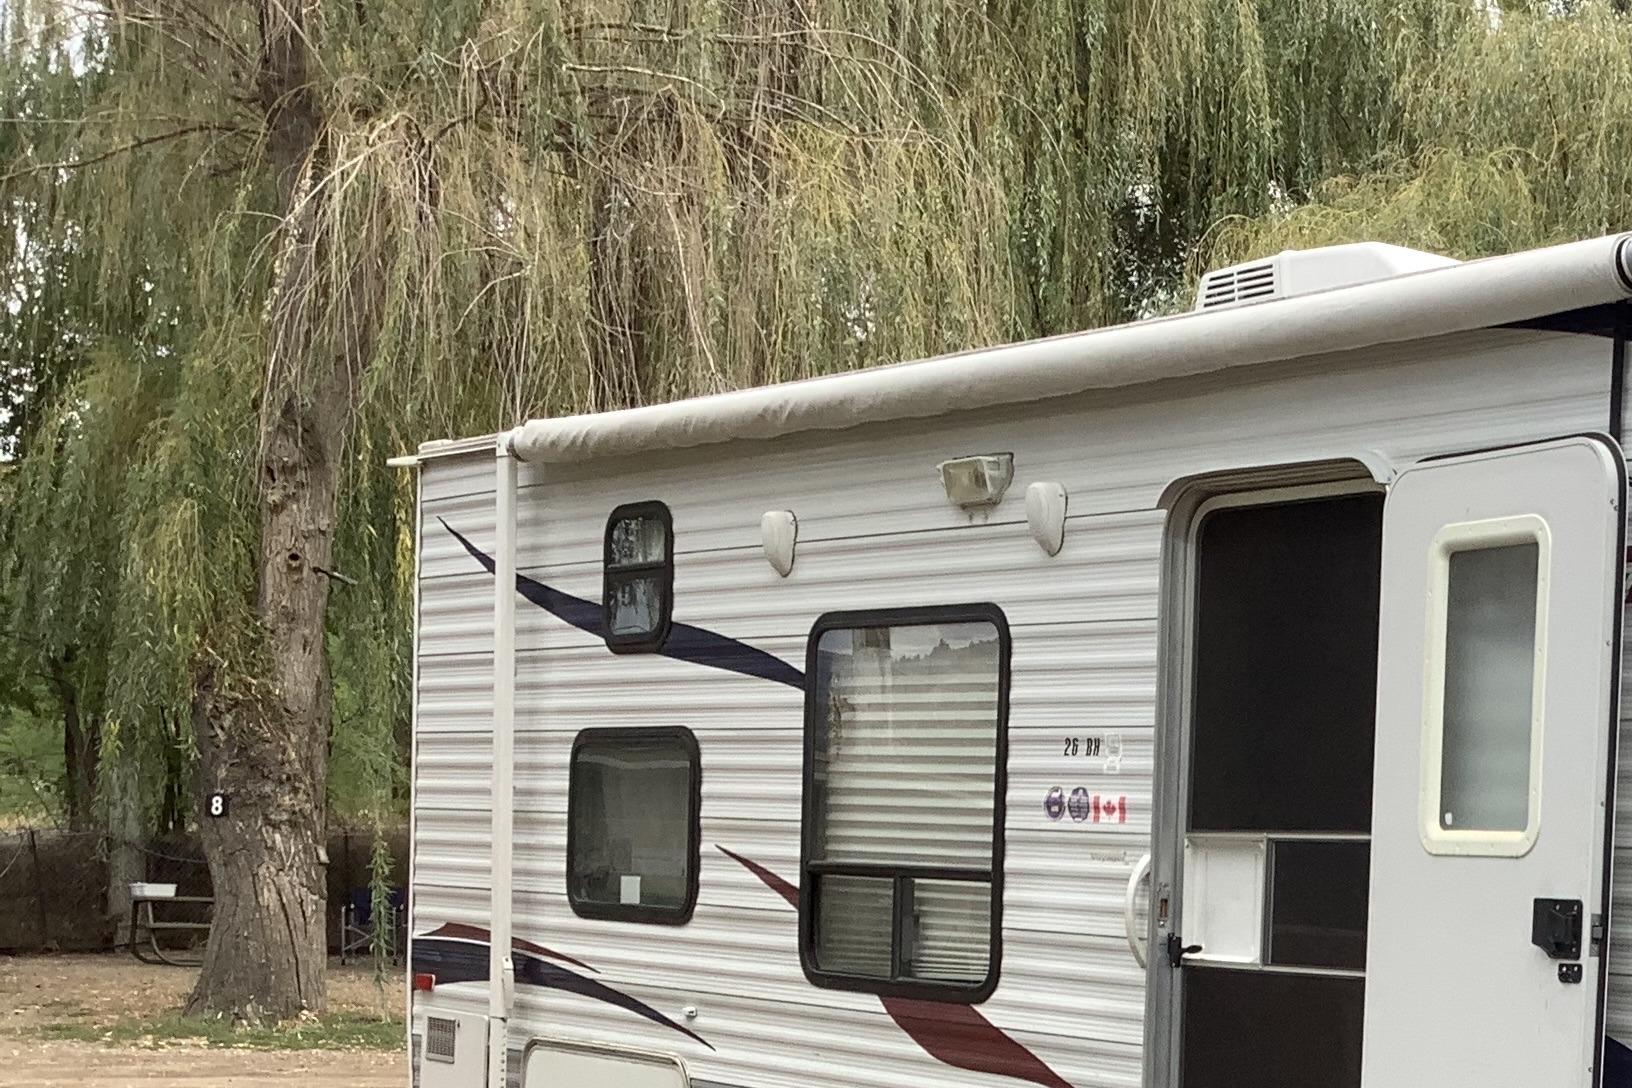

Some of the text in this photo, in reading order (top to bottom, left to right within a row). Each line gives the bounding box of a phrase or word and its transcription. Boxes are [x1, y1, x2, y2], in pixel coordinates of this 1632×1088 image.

[1063, 737, 1101, 757] 26 BH
[211, 795, 223, 816] 8
